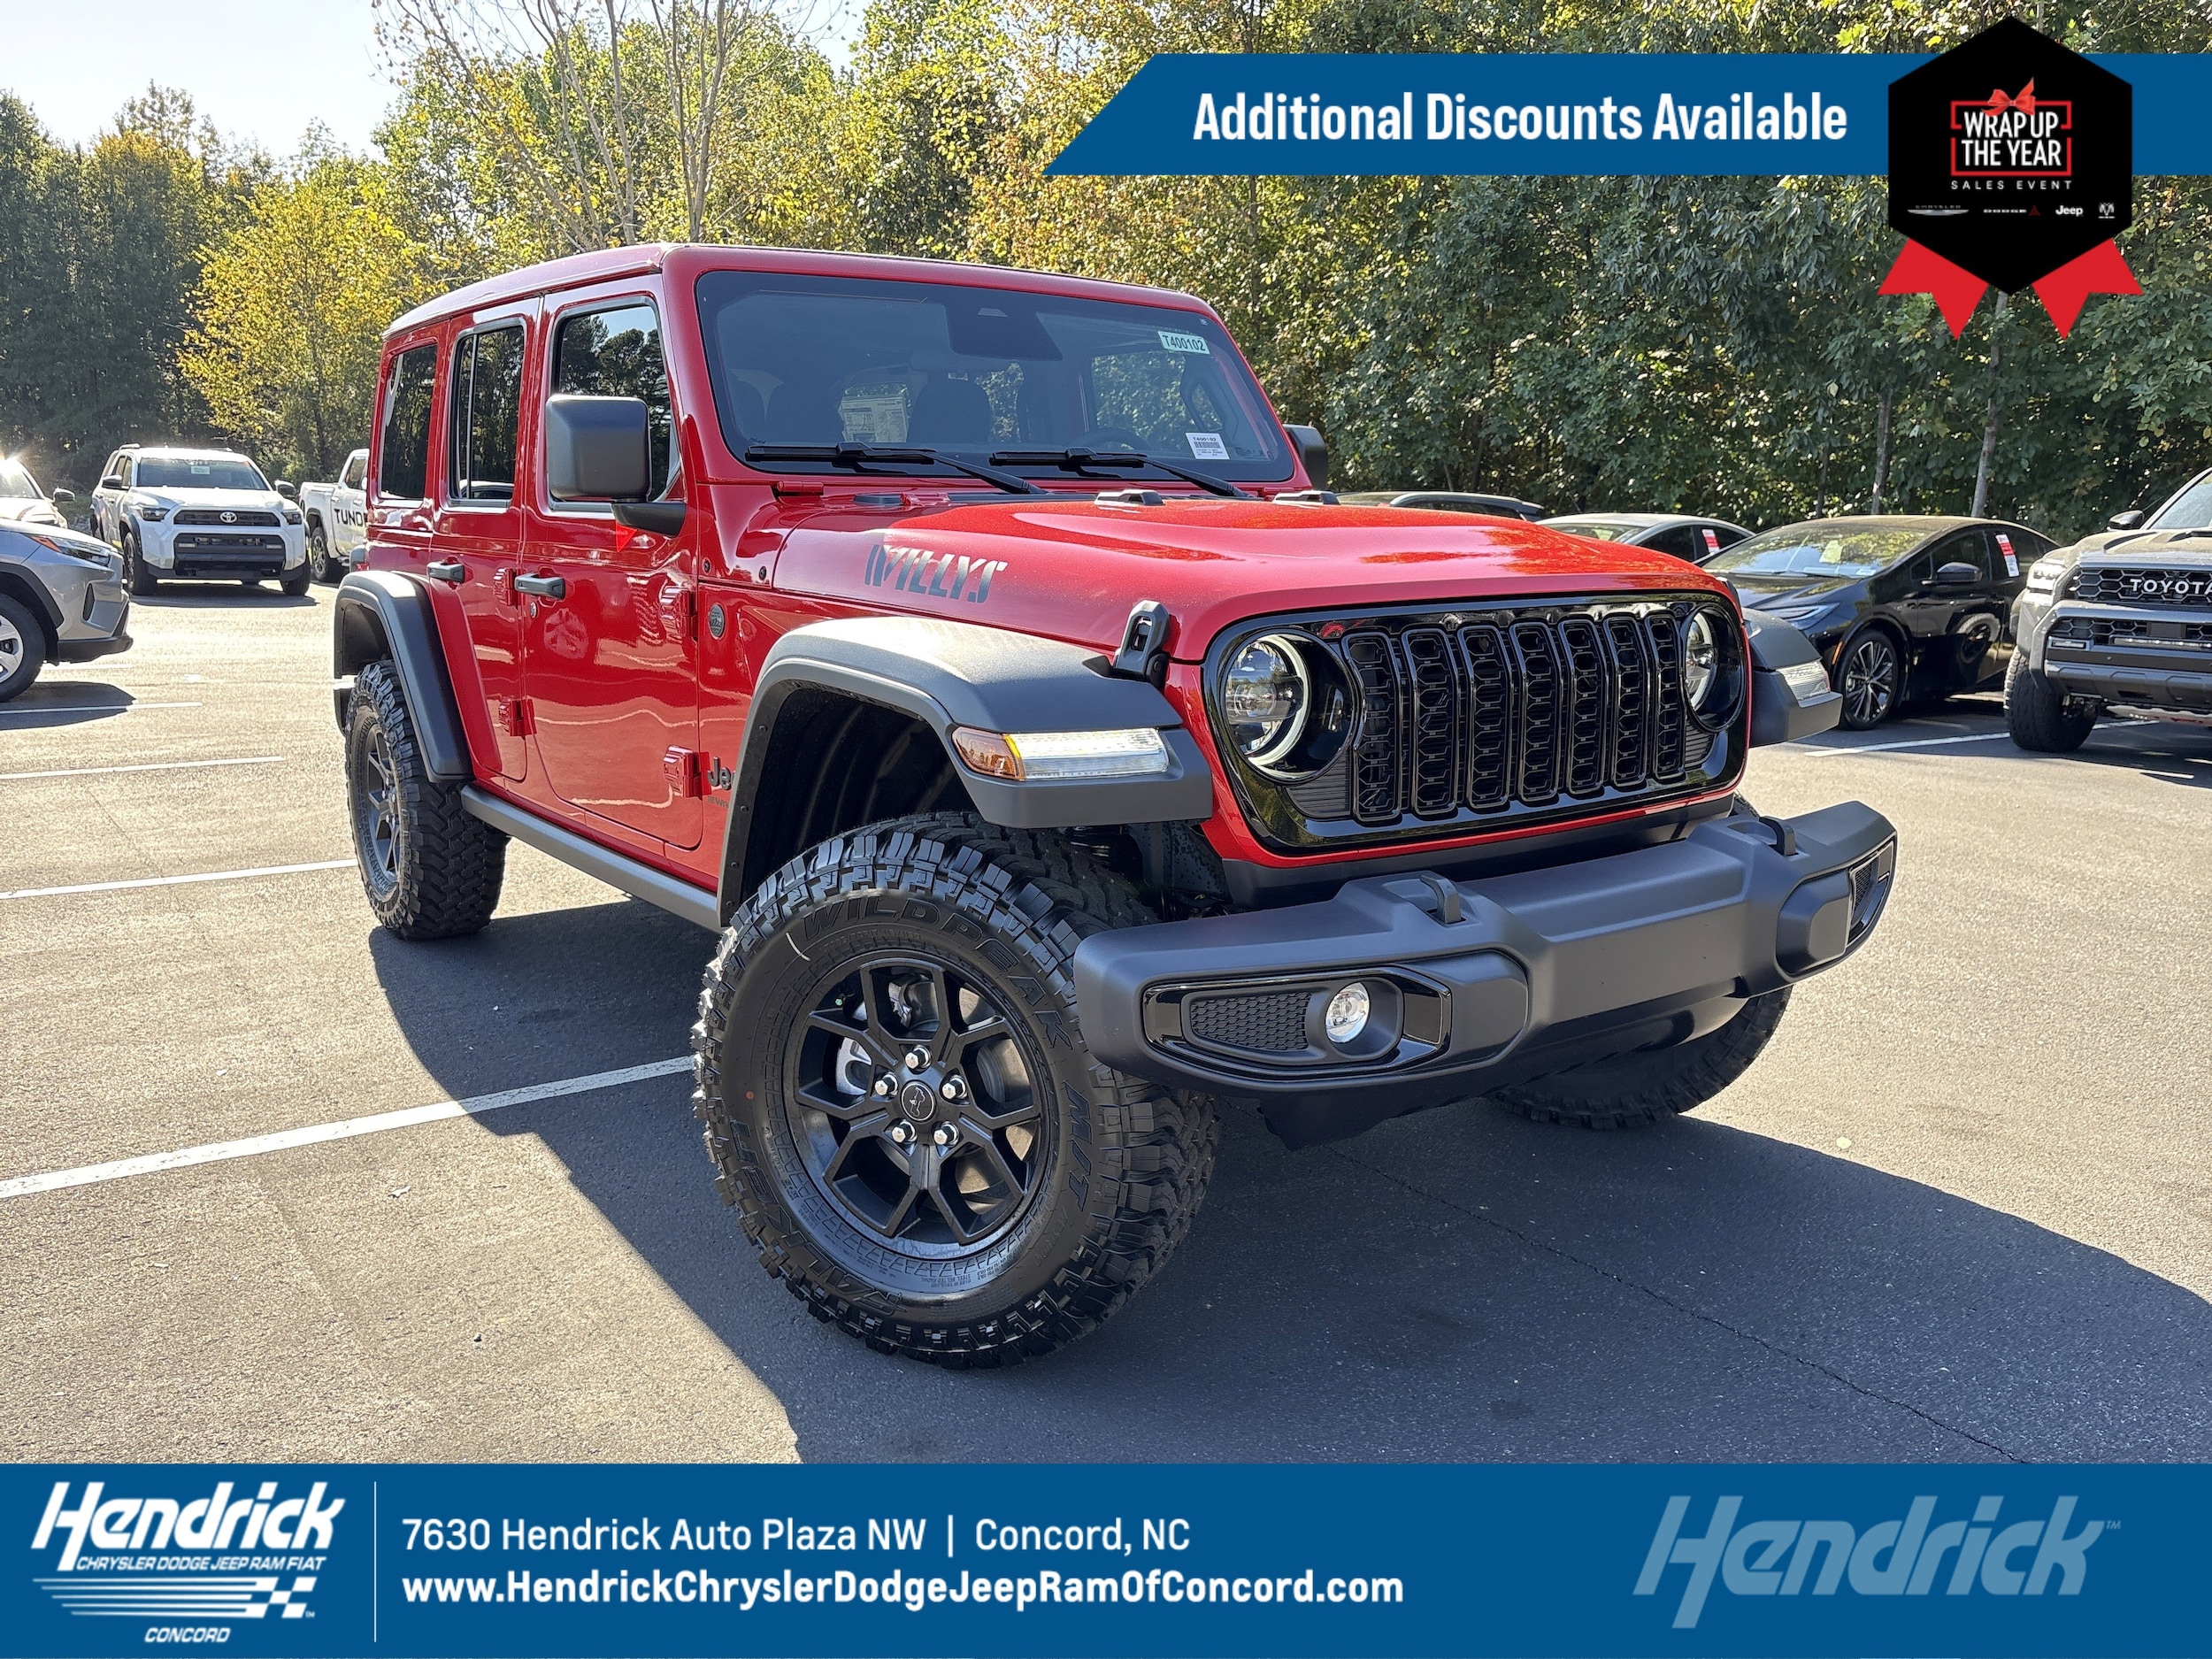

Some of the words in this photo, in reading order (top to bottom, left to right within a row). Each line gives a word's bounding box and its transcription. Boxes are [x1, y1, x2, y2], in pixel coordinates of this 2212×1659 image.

[1163, 335, 1205, 350] T400102
[864, 544, 1009, 603] WILLYS
[803, 895, 1074, 1050] WILDPEAK
